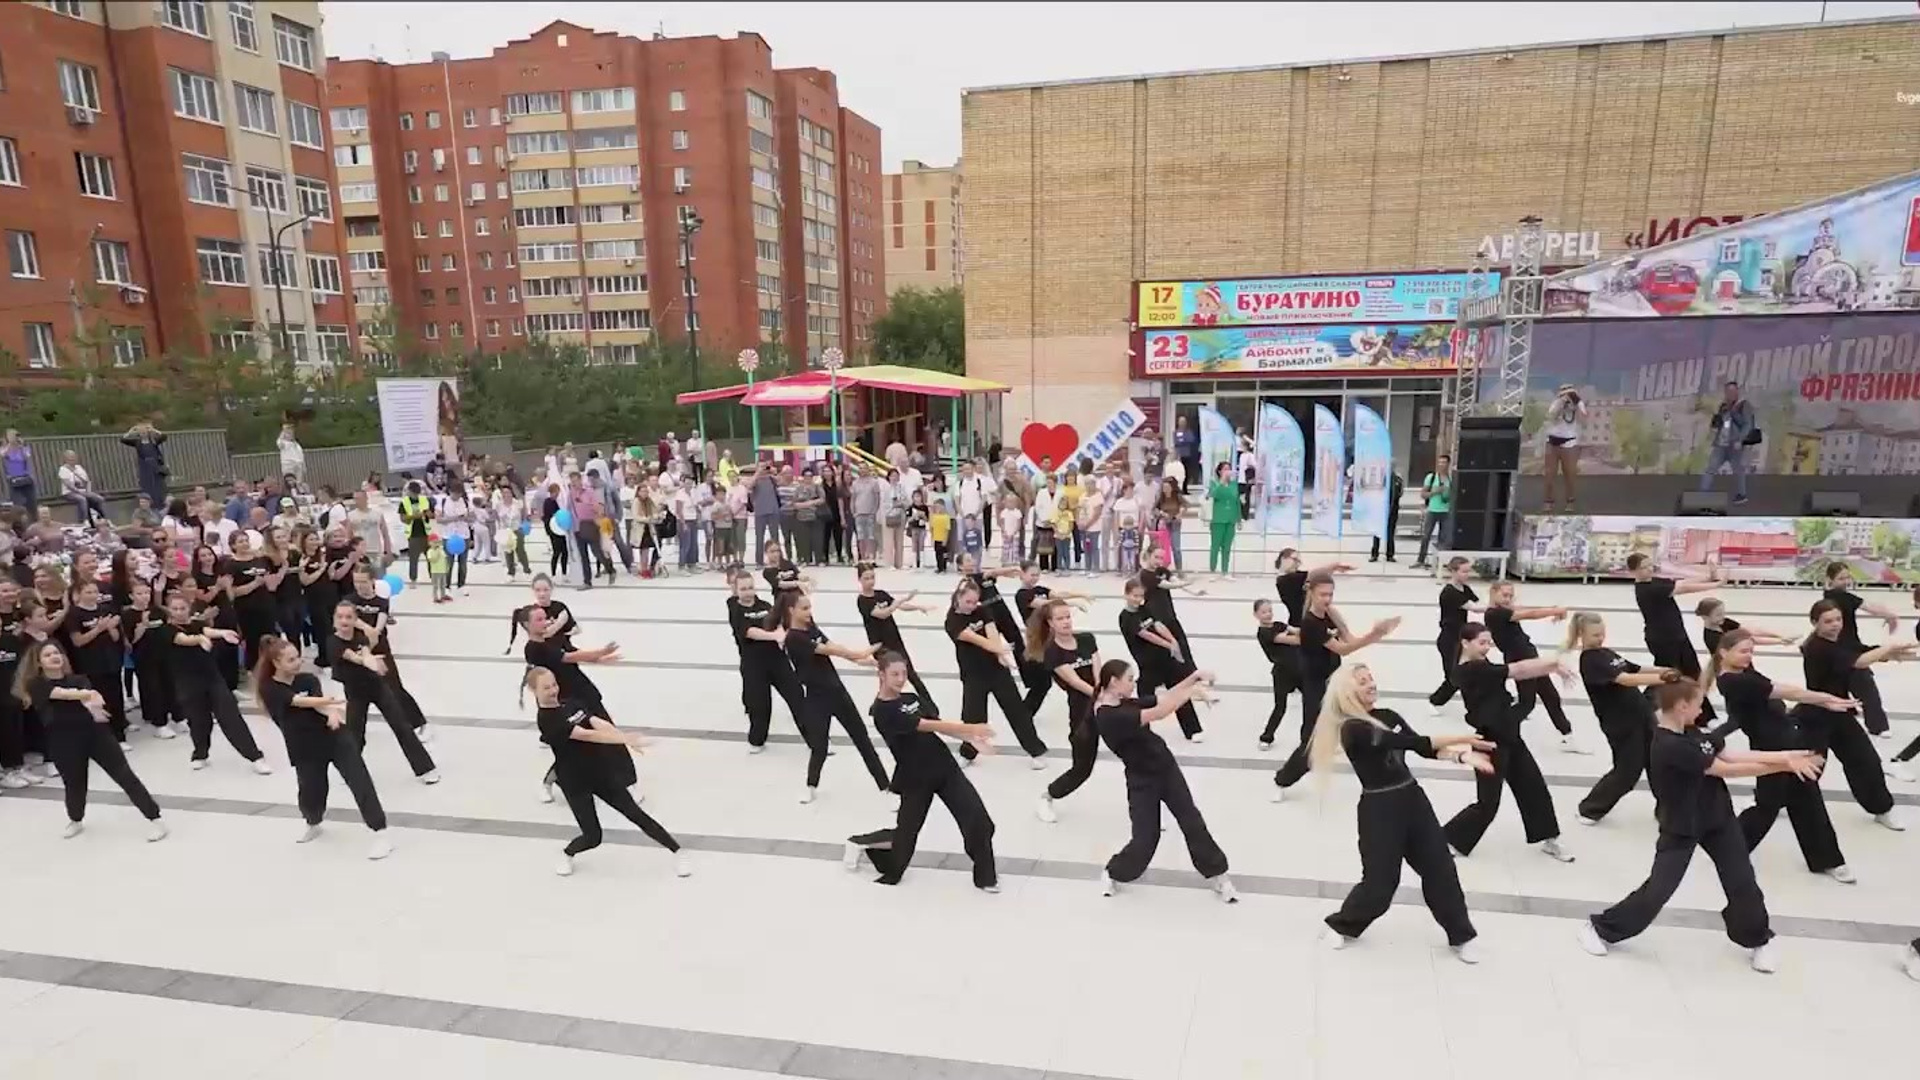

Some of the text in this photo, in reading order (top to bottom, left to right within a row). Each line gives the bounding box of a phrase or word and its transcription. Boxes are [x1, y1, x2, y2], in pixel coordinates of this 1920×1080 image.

[1477, 231, 1600, 262] ДВРЕЦ
[1152, 286, 1174, 304] 17
[1237, 290, 1360, 312] БУРАТИНО
[1149, 313, 1176, 321] 12:00
[1153, 335, 1188, 358] 23
[1246, 346, 1312, 358] Айболит
[1149, 360, 1192, 370] СЕНТЯБРЯ
[1258, 354, 1333, 369] Бармалей
[1637, 355, 1705, 400] НАШ
[1709, 334, 1832, 392] РОДНОЙ
